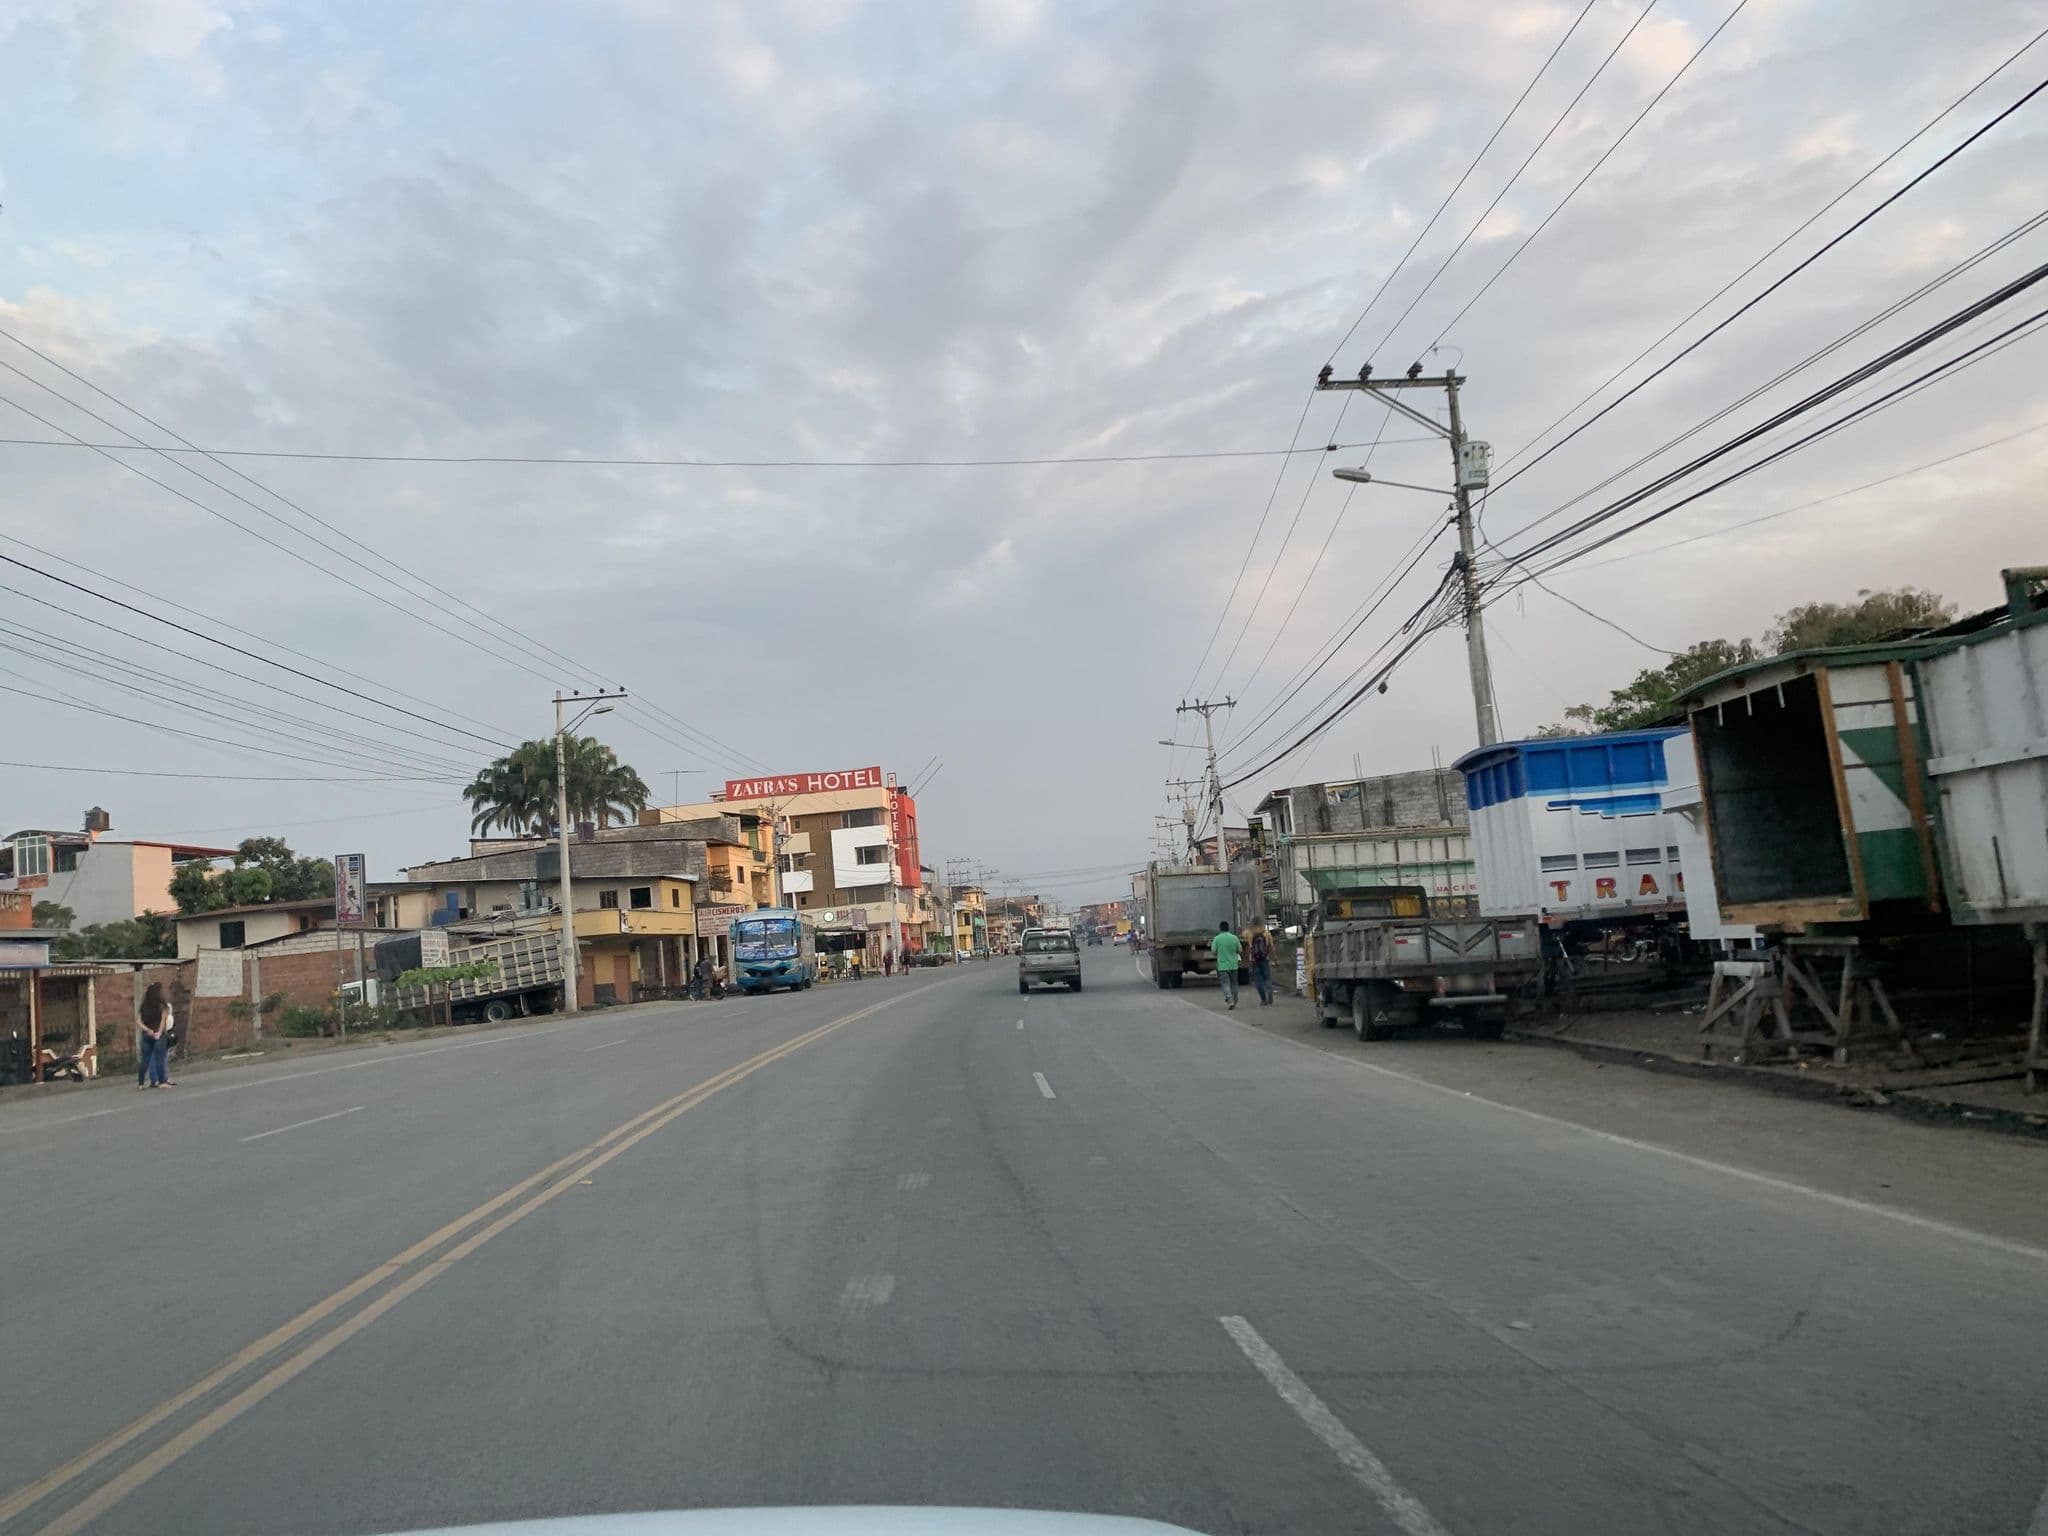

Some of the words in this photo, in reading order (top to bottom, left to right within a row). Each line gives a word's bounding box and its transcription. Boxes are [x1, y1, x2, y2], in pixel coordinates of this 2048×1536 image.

[732, 778, 798, 797] ZAFRA'S
[807, 770, 880, 791] HOTEL
[889, 790, 899, 842] HOTEL
[712, 906, 745, 916] CISNEROS
